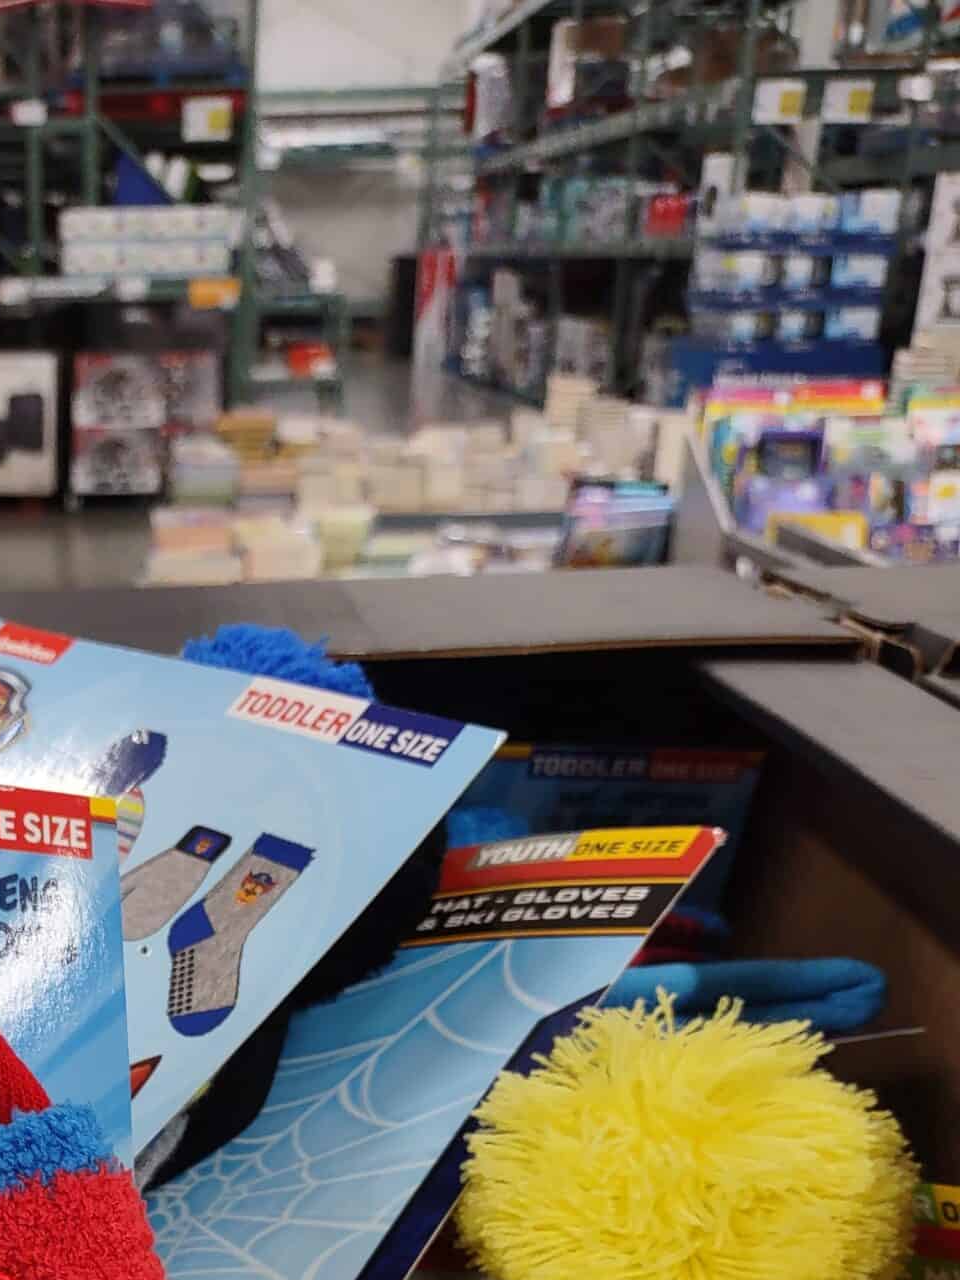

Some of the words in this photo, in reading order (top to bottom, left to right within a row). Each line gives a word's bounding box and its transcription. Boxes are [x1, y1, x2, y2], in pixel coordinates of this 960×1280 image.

[238, 689, 352, 737] TODDLER
[345, 719, 398, 749] ONE
[390, 729, 449, 762] SIZE
[22, 812, 87, 849] SIZE
[477, 838, 574, 868] YOUTH
[574, 841, 623, 857] ONE
[626, 839, 685, 854] SIZE
[431, 895, 490, 915] HAT
[513, 886, 651, 905] GLOVES
[443, 911, 496, 929] SKI
[500, 904, 638, 923] GLOVES
